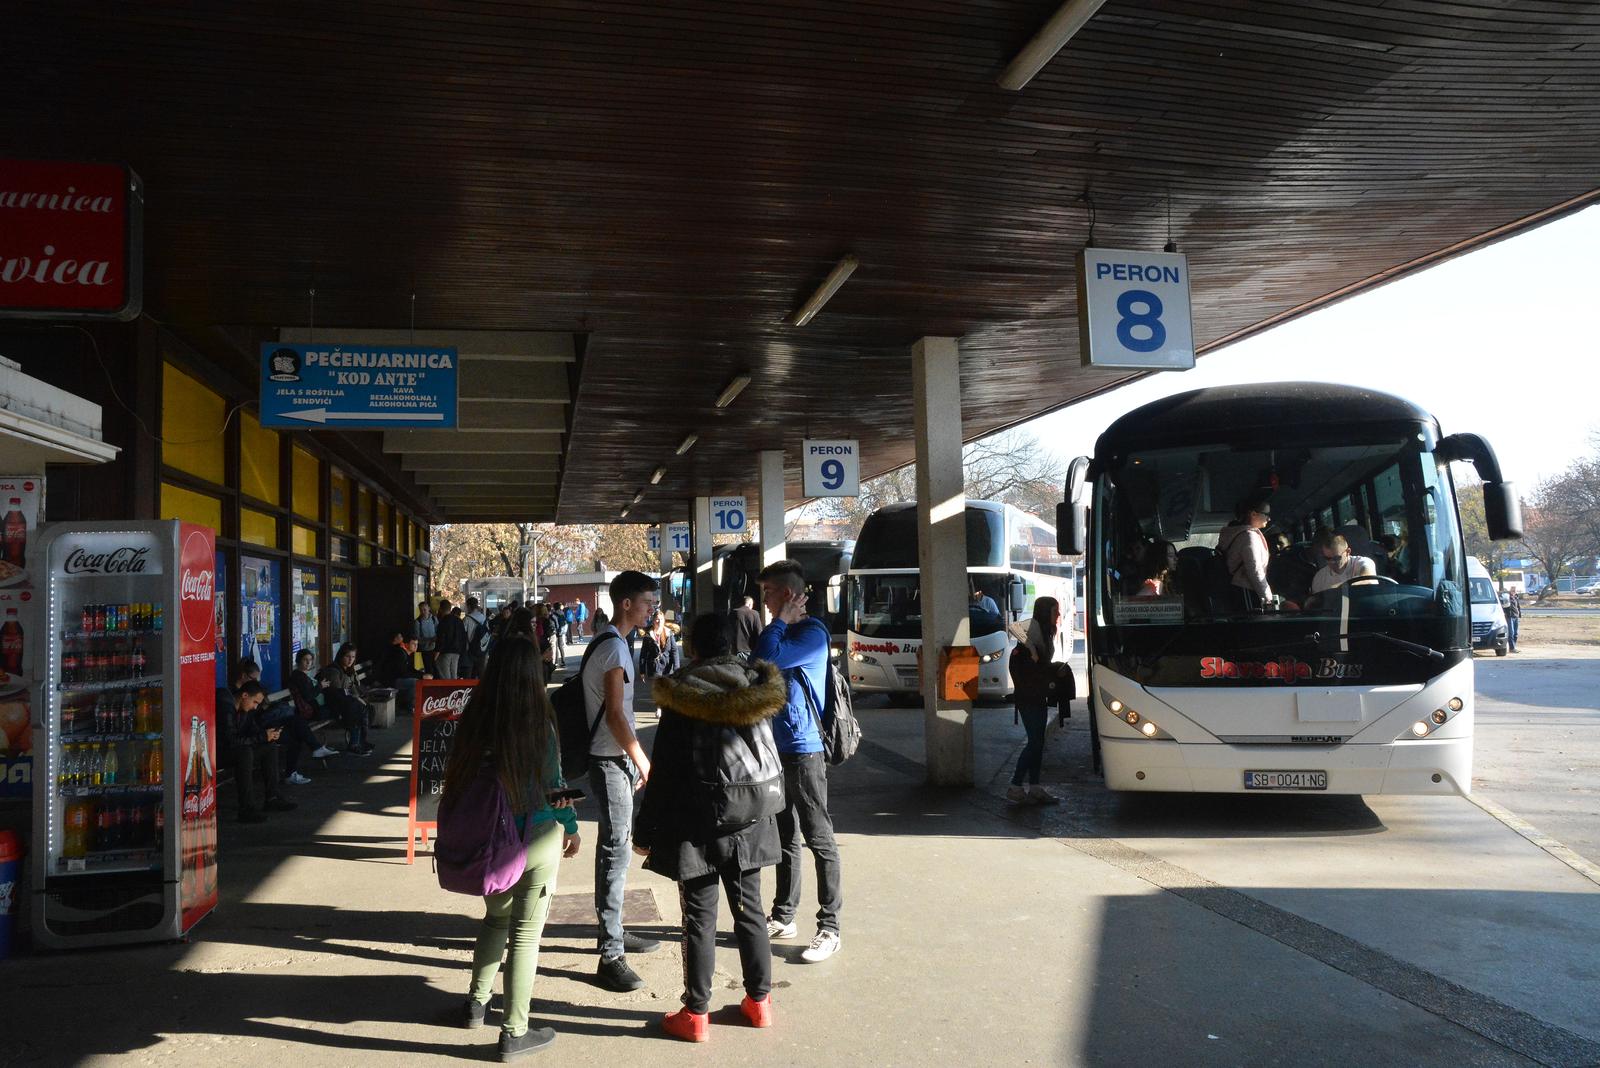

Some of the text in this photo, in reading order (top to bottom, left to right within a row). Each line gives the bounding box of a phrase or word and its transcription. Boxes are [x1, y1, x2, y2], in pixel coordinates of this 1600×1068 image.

[0, 245, 113, 286] vica
[1096, 262, 1180, 284] PERON
[1116, 289, 1167, 353] 8
[305, 346, 453, 369] PEČENJARNICA
[276, 388, 296, 396] JELA
[370, 394, 432, 402] BEZALKOHOLNA
[393, 386, 415, 394] KAVA
[810, 446, 852, 455] PERON
[820, 459, 845, 490] 9
[714, 509, 744, 530] 10
[672, 533, 689, 548] 11
[902, 643, 918, 654] Bu
[1200, 656, 1363, 684] Slavonija Bus
[420, 739, 447, 753] JELA
[421, 756, 447, 773] KAV
[1254, 773, 1269, 786] SB
